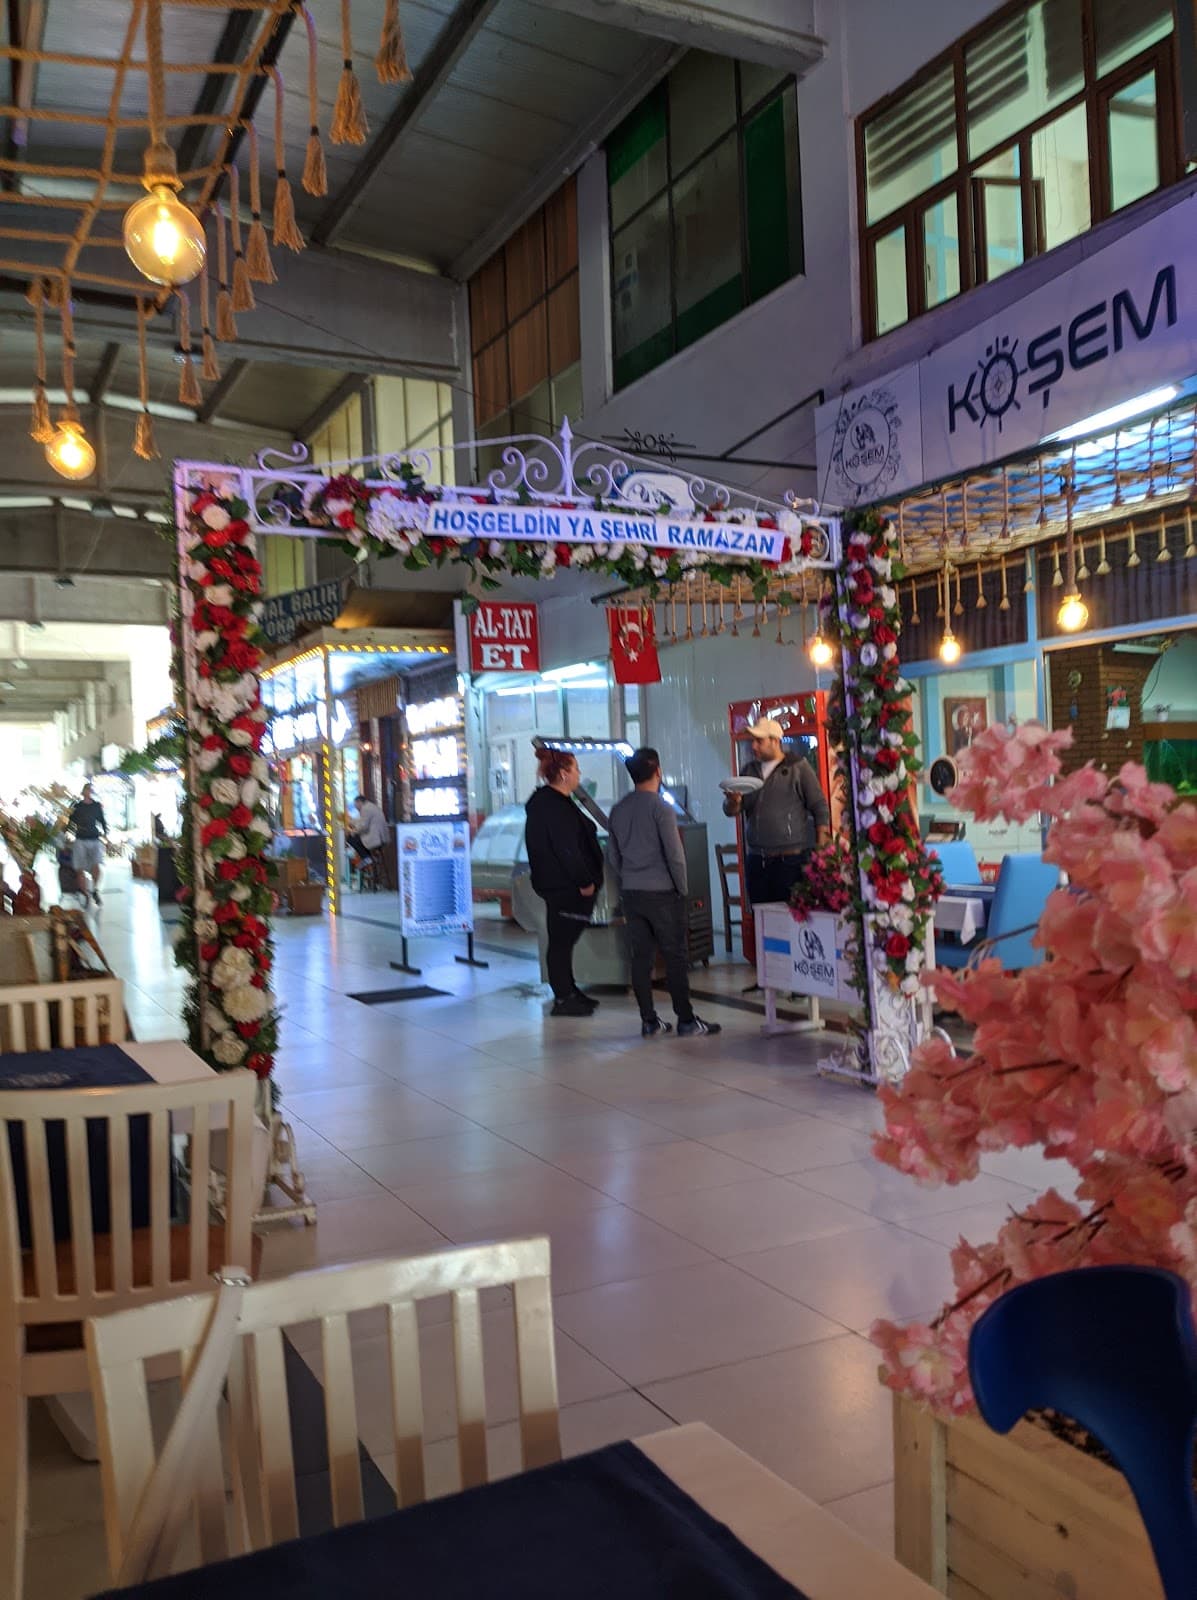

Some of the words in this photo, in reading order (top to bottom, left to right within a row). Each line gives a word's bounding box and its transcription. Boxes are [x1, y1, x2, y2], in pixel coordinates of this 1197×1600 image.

[947, 263, 1178, 434] KÖŞEM
[433, 509, 561, 537] HOŞGELDİN
[567, 515, 595, 538] YA
[668, 525, 775, 555] RAMAZAN
[291, 583, 338, 613] BALIK
[473, 607, 534, 639] AL-TAT
[480, 643, 530, 669] ET
